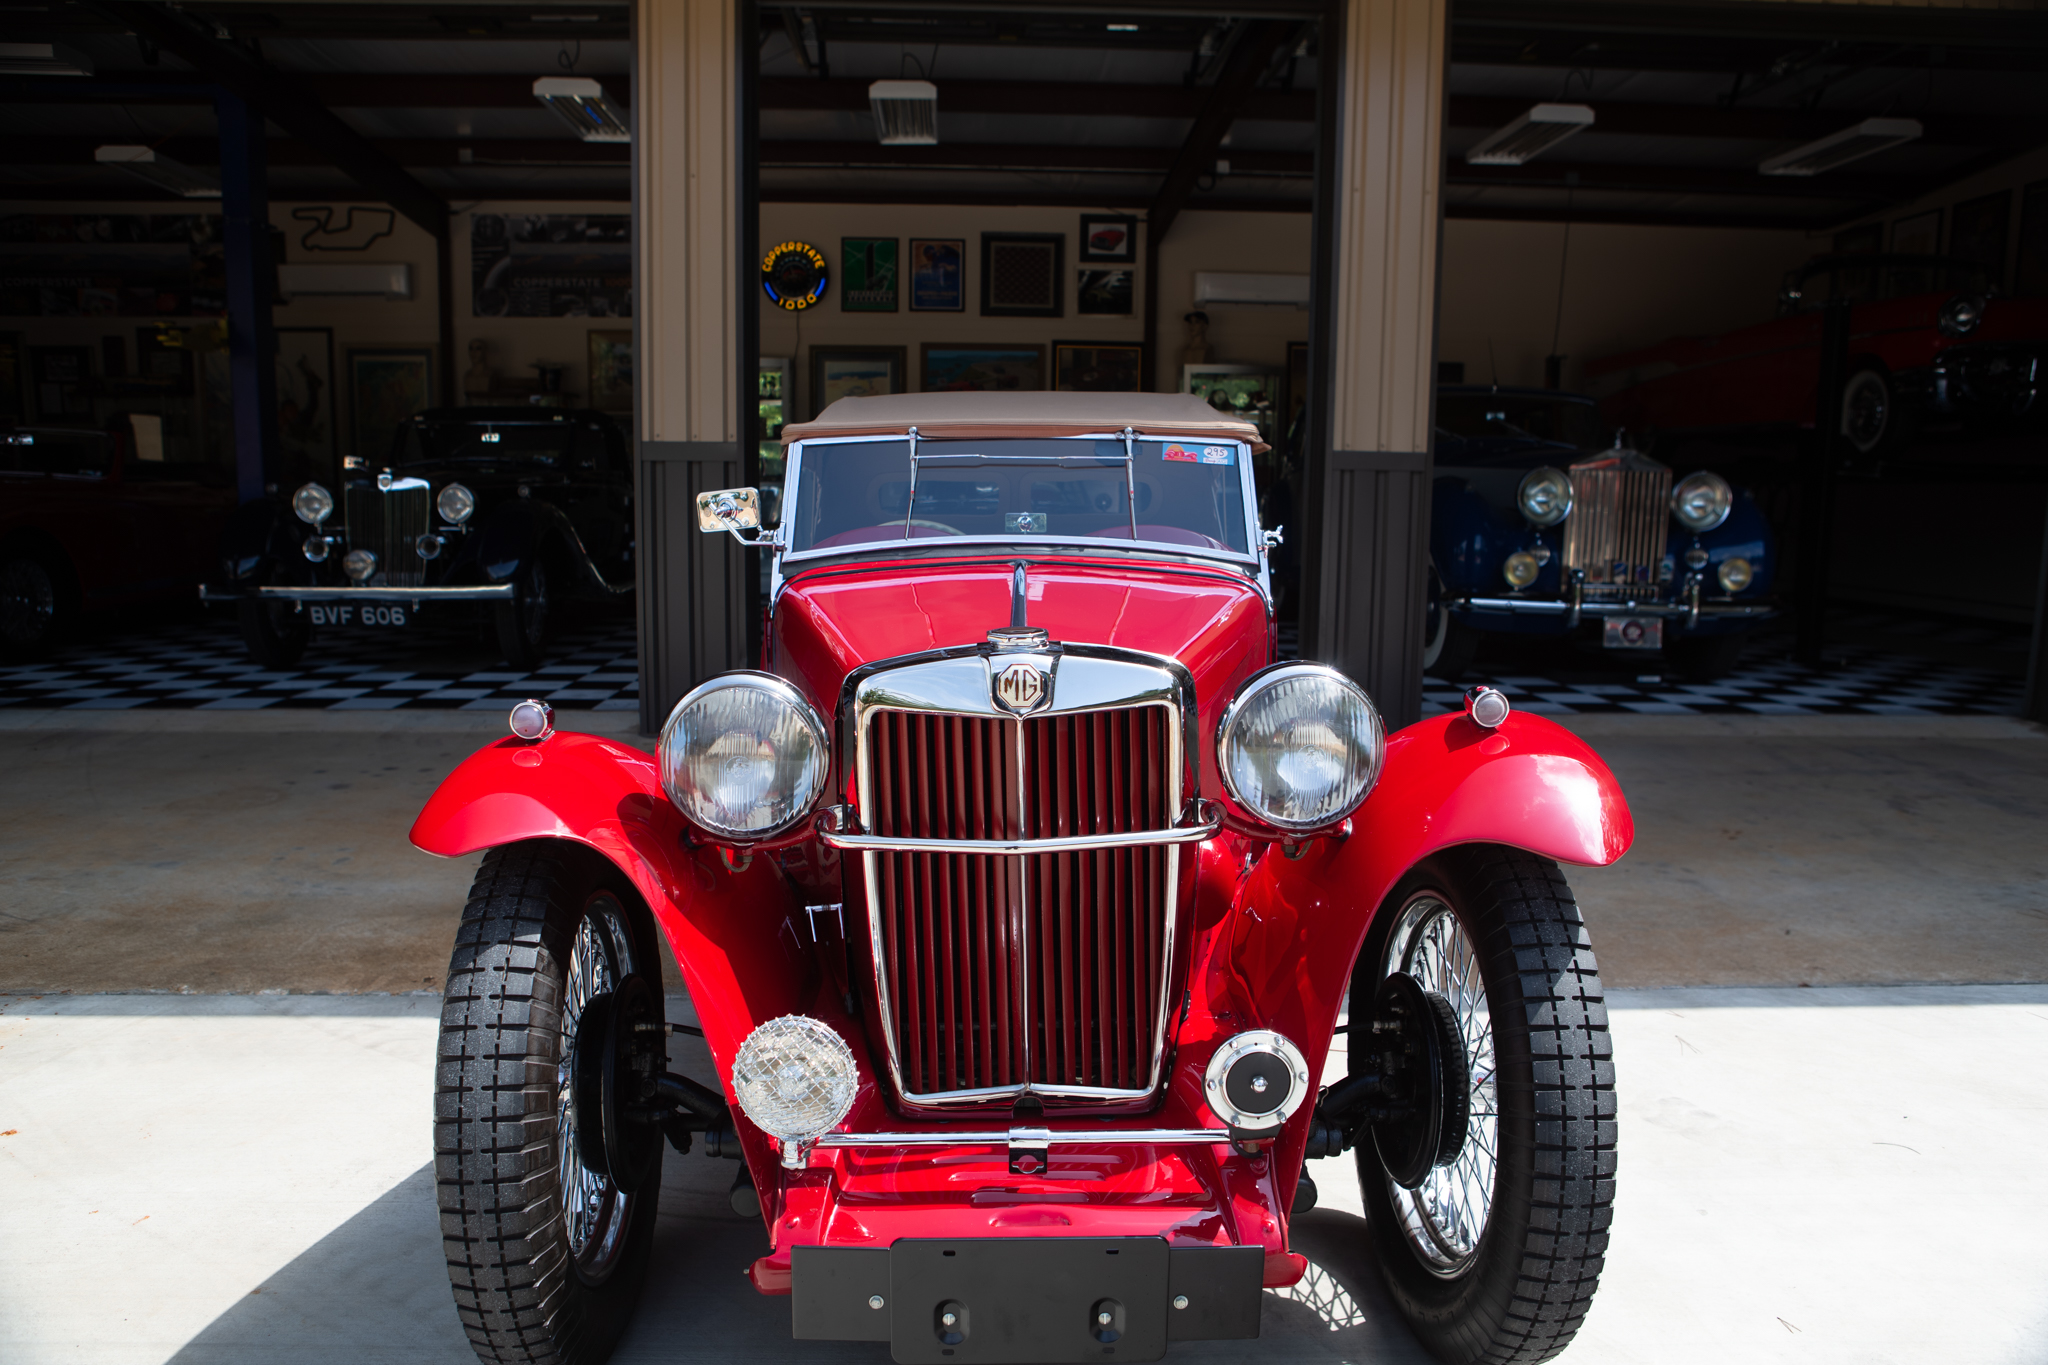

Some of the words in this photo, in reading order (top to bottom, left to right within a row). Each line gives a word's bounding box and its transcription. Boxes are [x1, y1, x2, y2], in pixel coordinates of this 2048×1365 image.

[762, 241, 825, 272] COPPERSTATE
[513, 278, 602, 289] COPPERSTATE
[779, 297, 817, 310] 1000
[1207, 447, 1225, 457] 295
[310, 605, 354, 625] BVF
[360, 606, 406, 626] 606
[1004, 669, 1038, 702] MG
